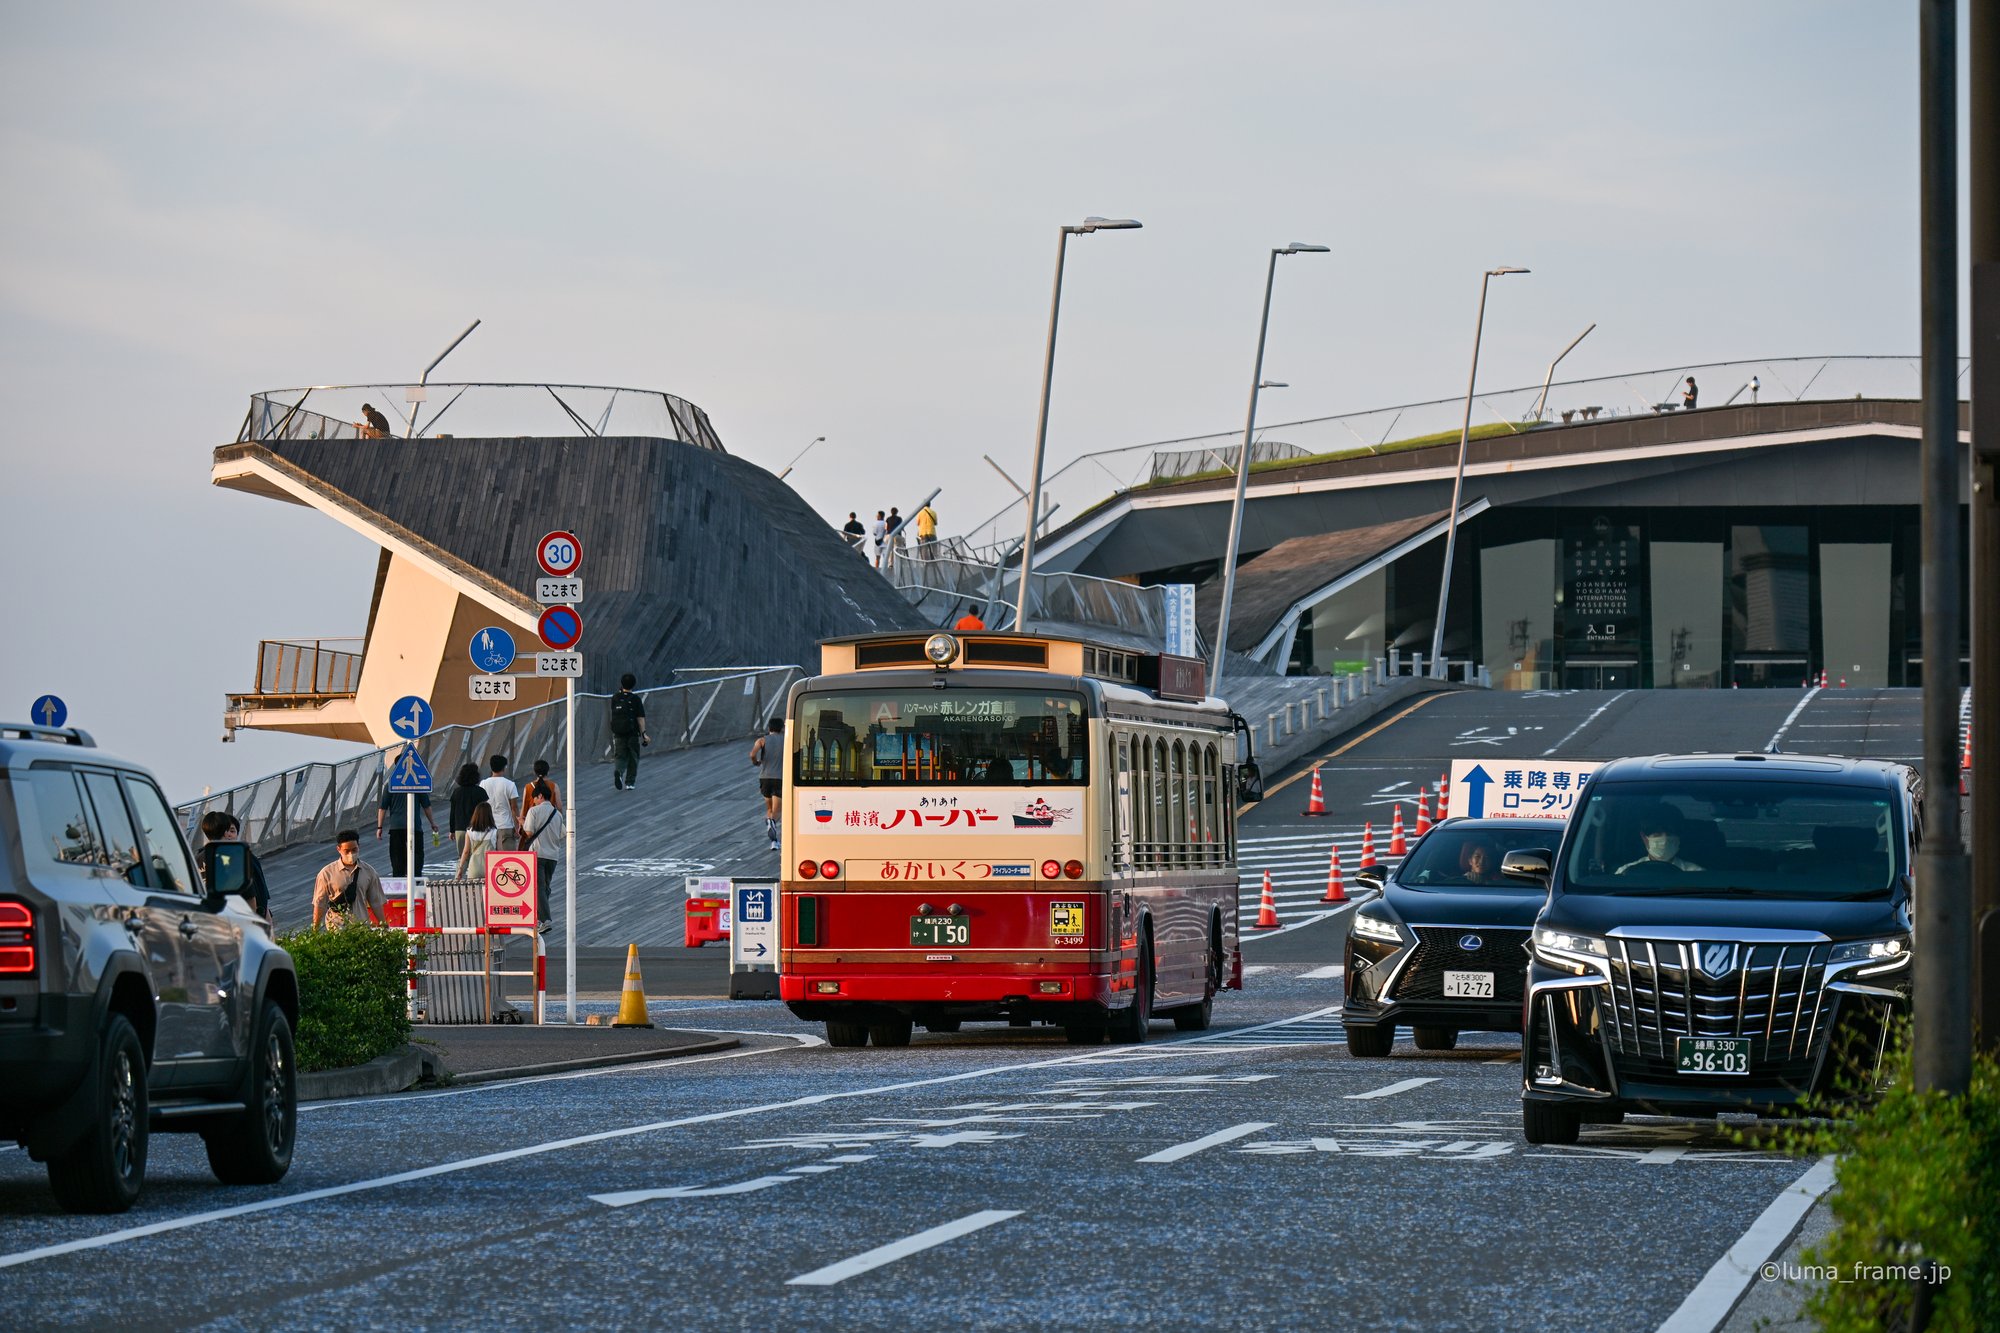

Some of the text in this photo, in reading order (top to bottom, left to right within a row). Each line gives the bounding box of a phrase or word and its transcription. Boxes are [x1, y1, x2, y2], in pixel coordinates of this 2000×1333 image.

[548, 544, 573, 564] 30
[542, 584, 578, 598] ここまで
[1587, 624, 1615, 634] 入口
[541, 658, 578, 671] ここまで
[474, 681, 511, 694] ここまで
[876, 701, 1016, 720] A ハンマーヘッド 赤レンガ倉庫
[919, 797, 957, 807] ありあけ
[880, 808, 999, 830] ハーバー
[880, 861, 992, 880] あかいくつ
[1054, 937, 1083, 945] 6-3499
[1457, 982, 1491, 995] 12-72
[1717, 1041, 1735, 1051] 330
[1682, 1052, 1746, 1072] あ 96-03
